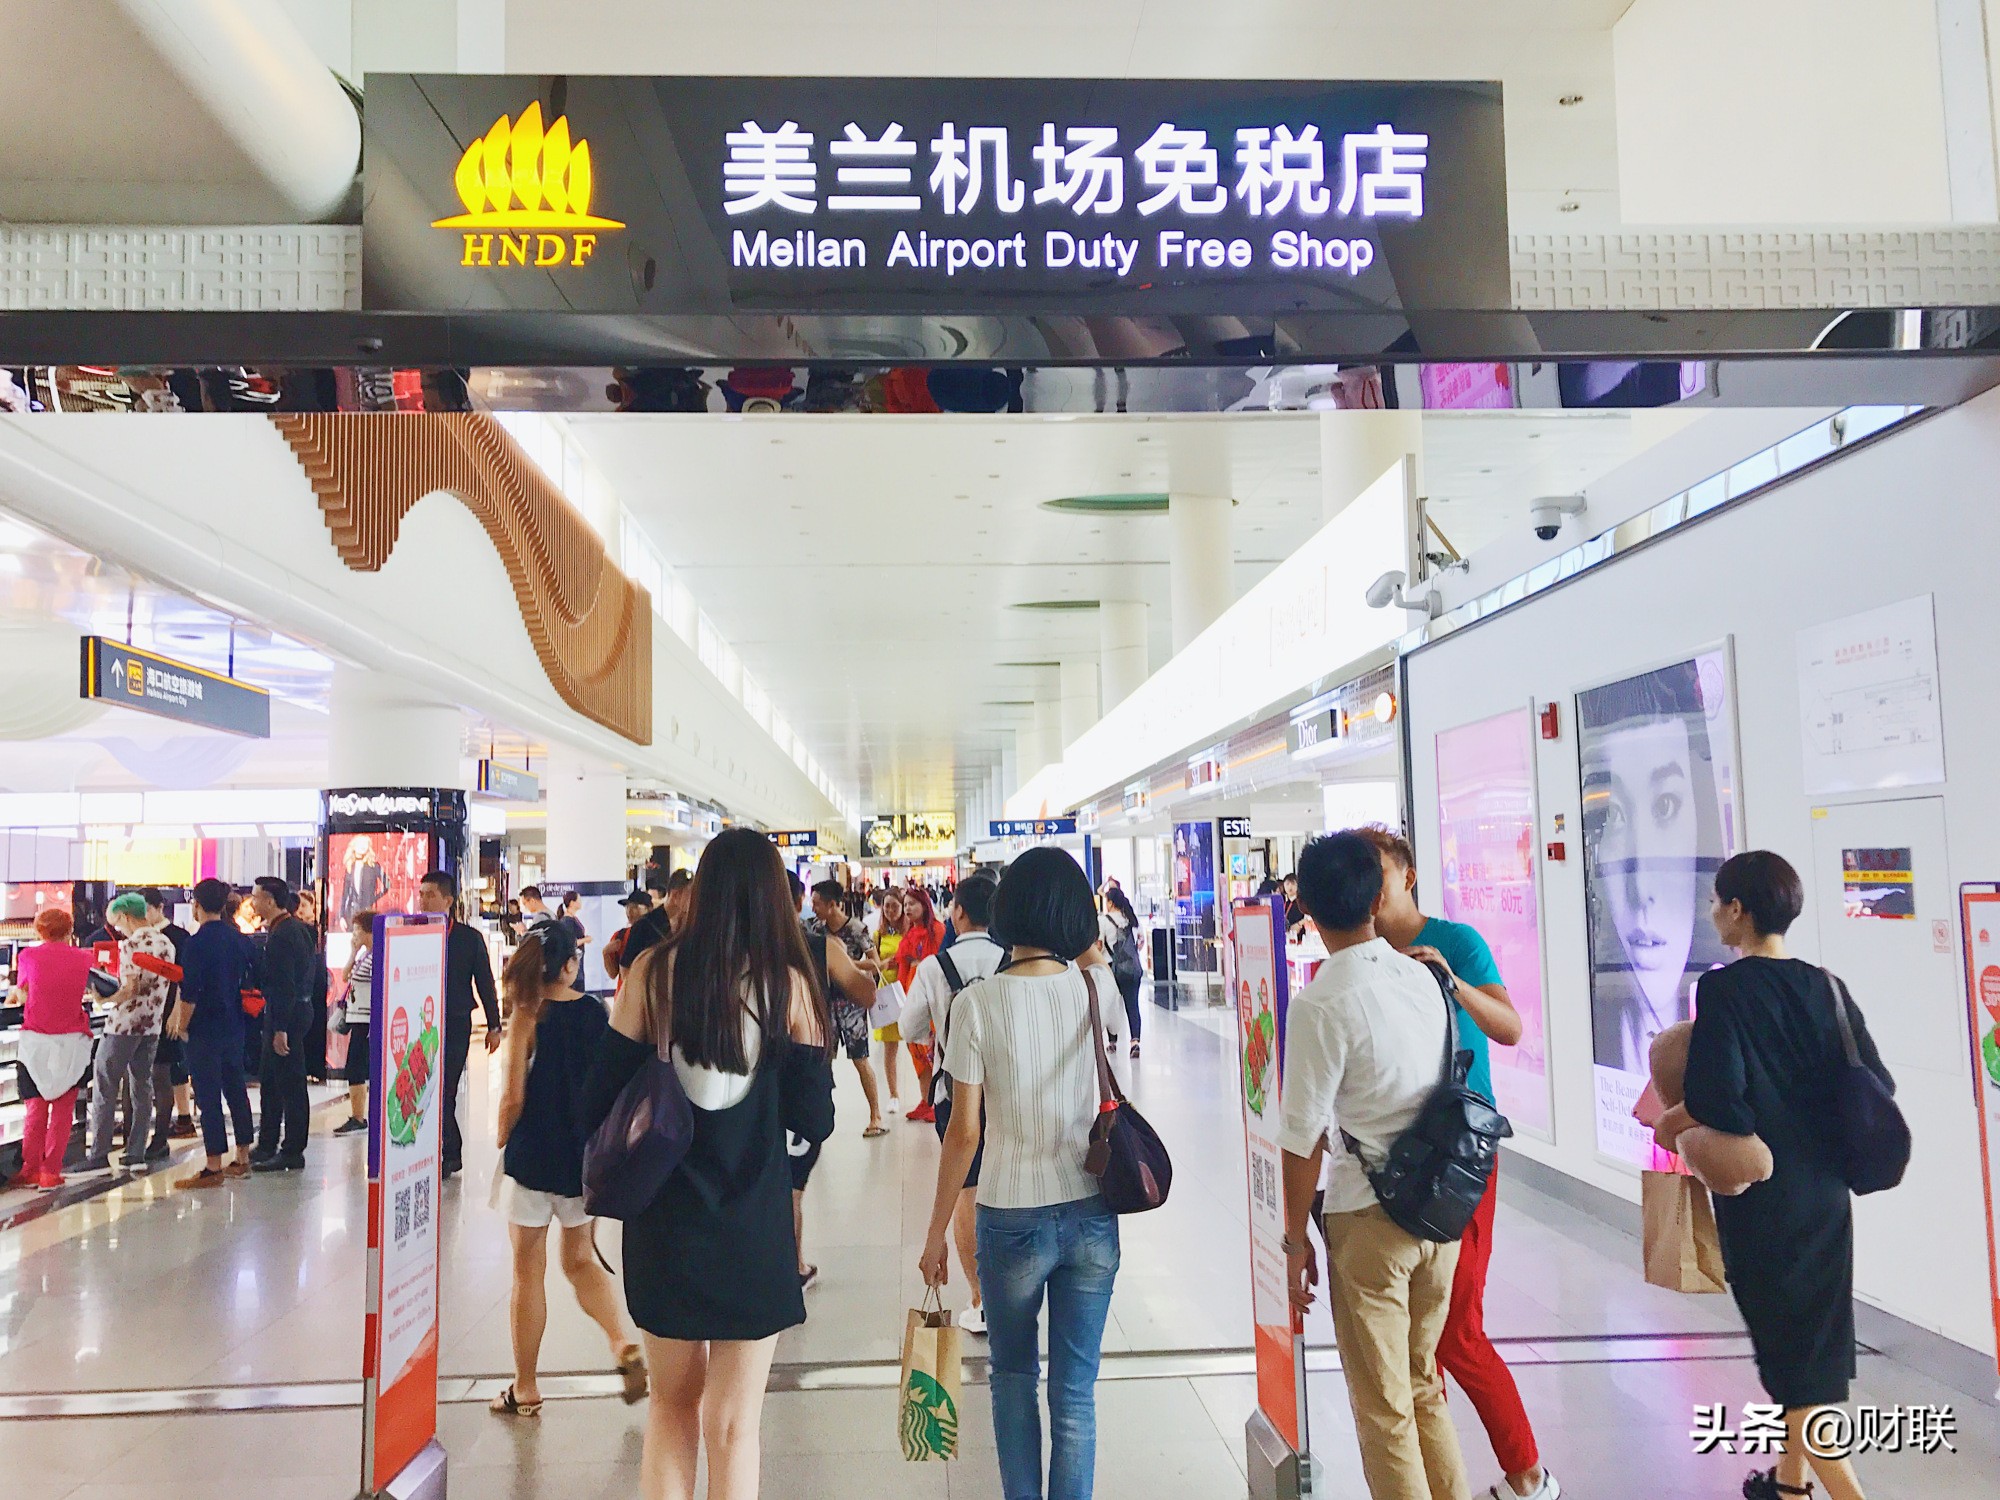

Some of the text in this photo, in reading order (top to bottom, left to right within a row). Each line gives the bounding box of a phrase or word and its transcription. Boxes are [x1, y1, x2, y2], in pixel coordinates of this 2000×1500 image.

[723, 121, 1429, 217] 美兰机场免税店
[461, 233, 598, 267] HNDF
[732, 230, 1374, 276] Meilan Airport Duty Free Shop
[146, 666, 203, 701] 海口航空旅游城
[1297, 721, 1318, 749] Dior
[997, 823, 1011, 835] 19
[1501, 888, 1523, 915] 60元
[1600, 1076, 1613, 1093] The
